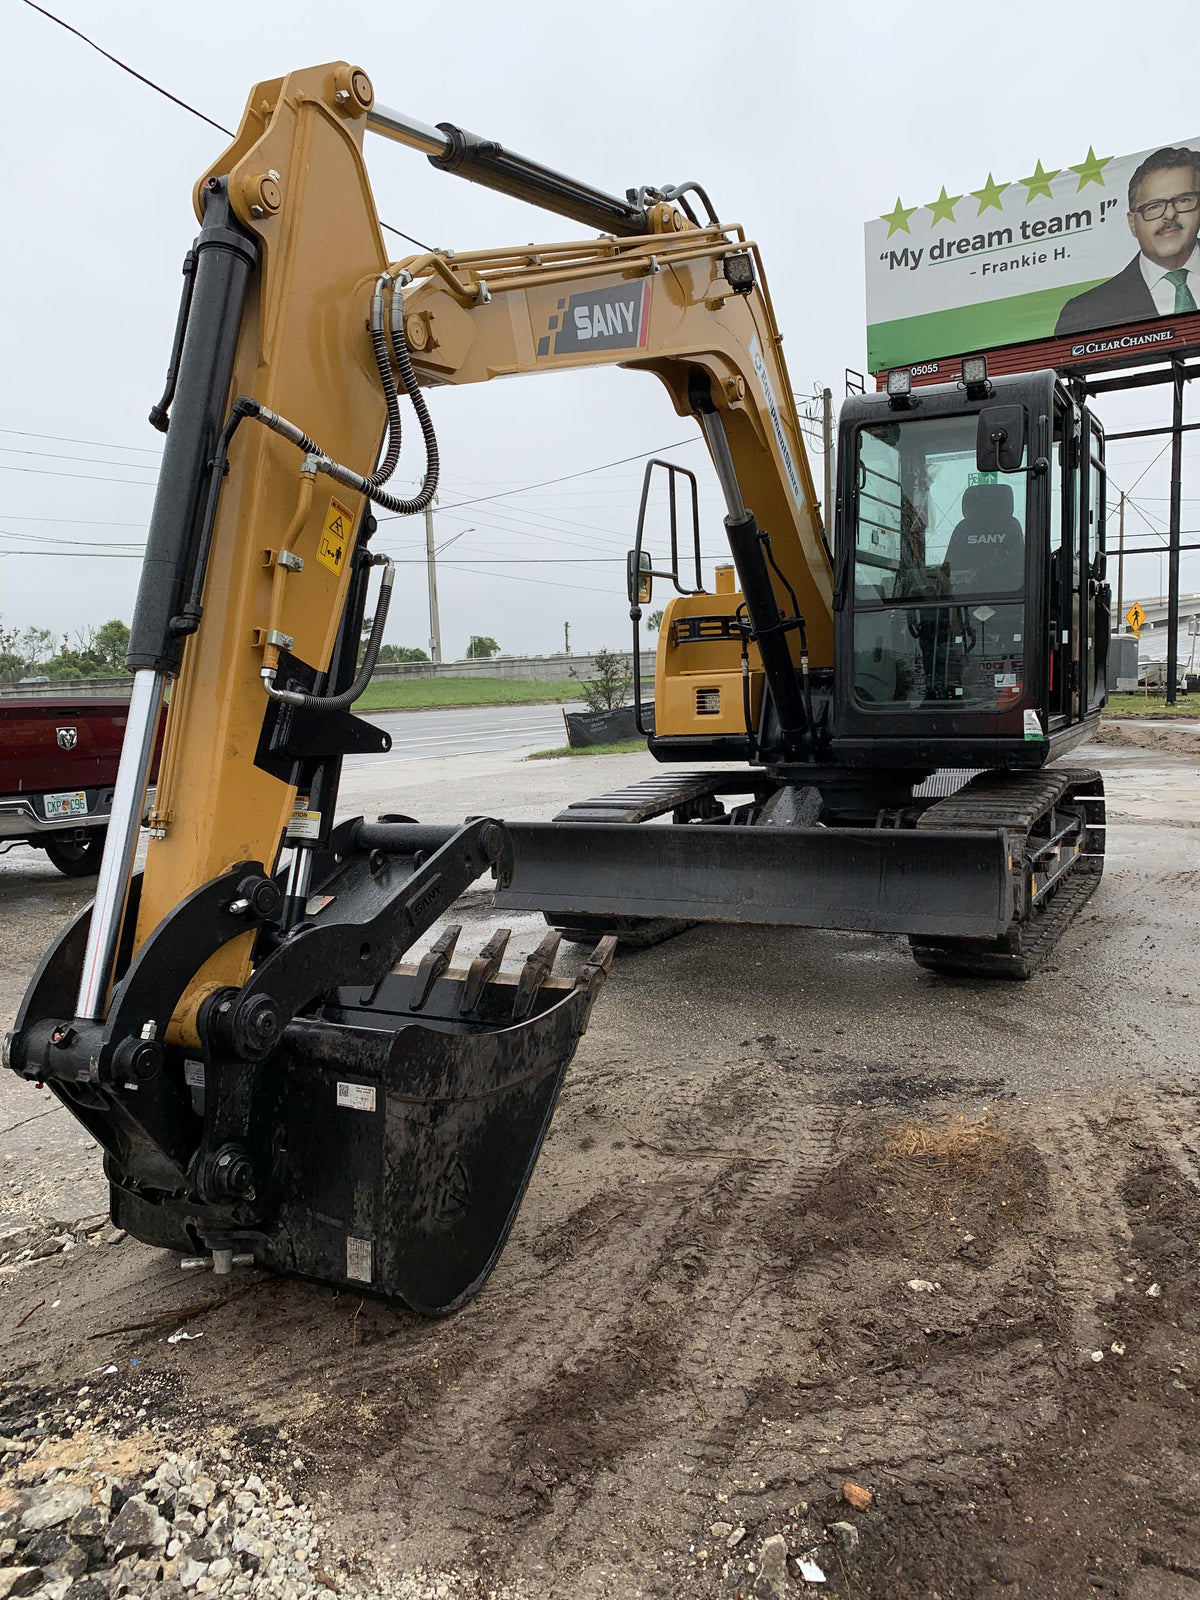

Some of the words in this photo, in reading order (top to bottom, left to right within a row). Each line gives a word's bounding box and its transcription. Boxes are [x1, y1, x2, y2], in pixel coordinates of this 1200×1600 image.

[929, 228, 1013, 261] dream
[1020, 209, 1092, 240] team
[982, 252, 1047, 276] Frankie
[1054, 246, 1071, 261] H.
[574, 301, 634, 340] SANY
[911, 363, 938, 376] 05055
[761, 370, 799, 497] EquipmentShare
[967, 533, 1007, 545] SANY
